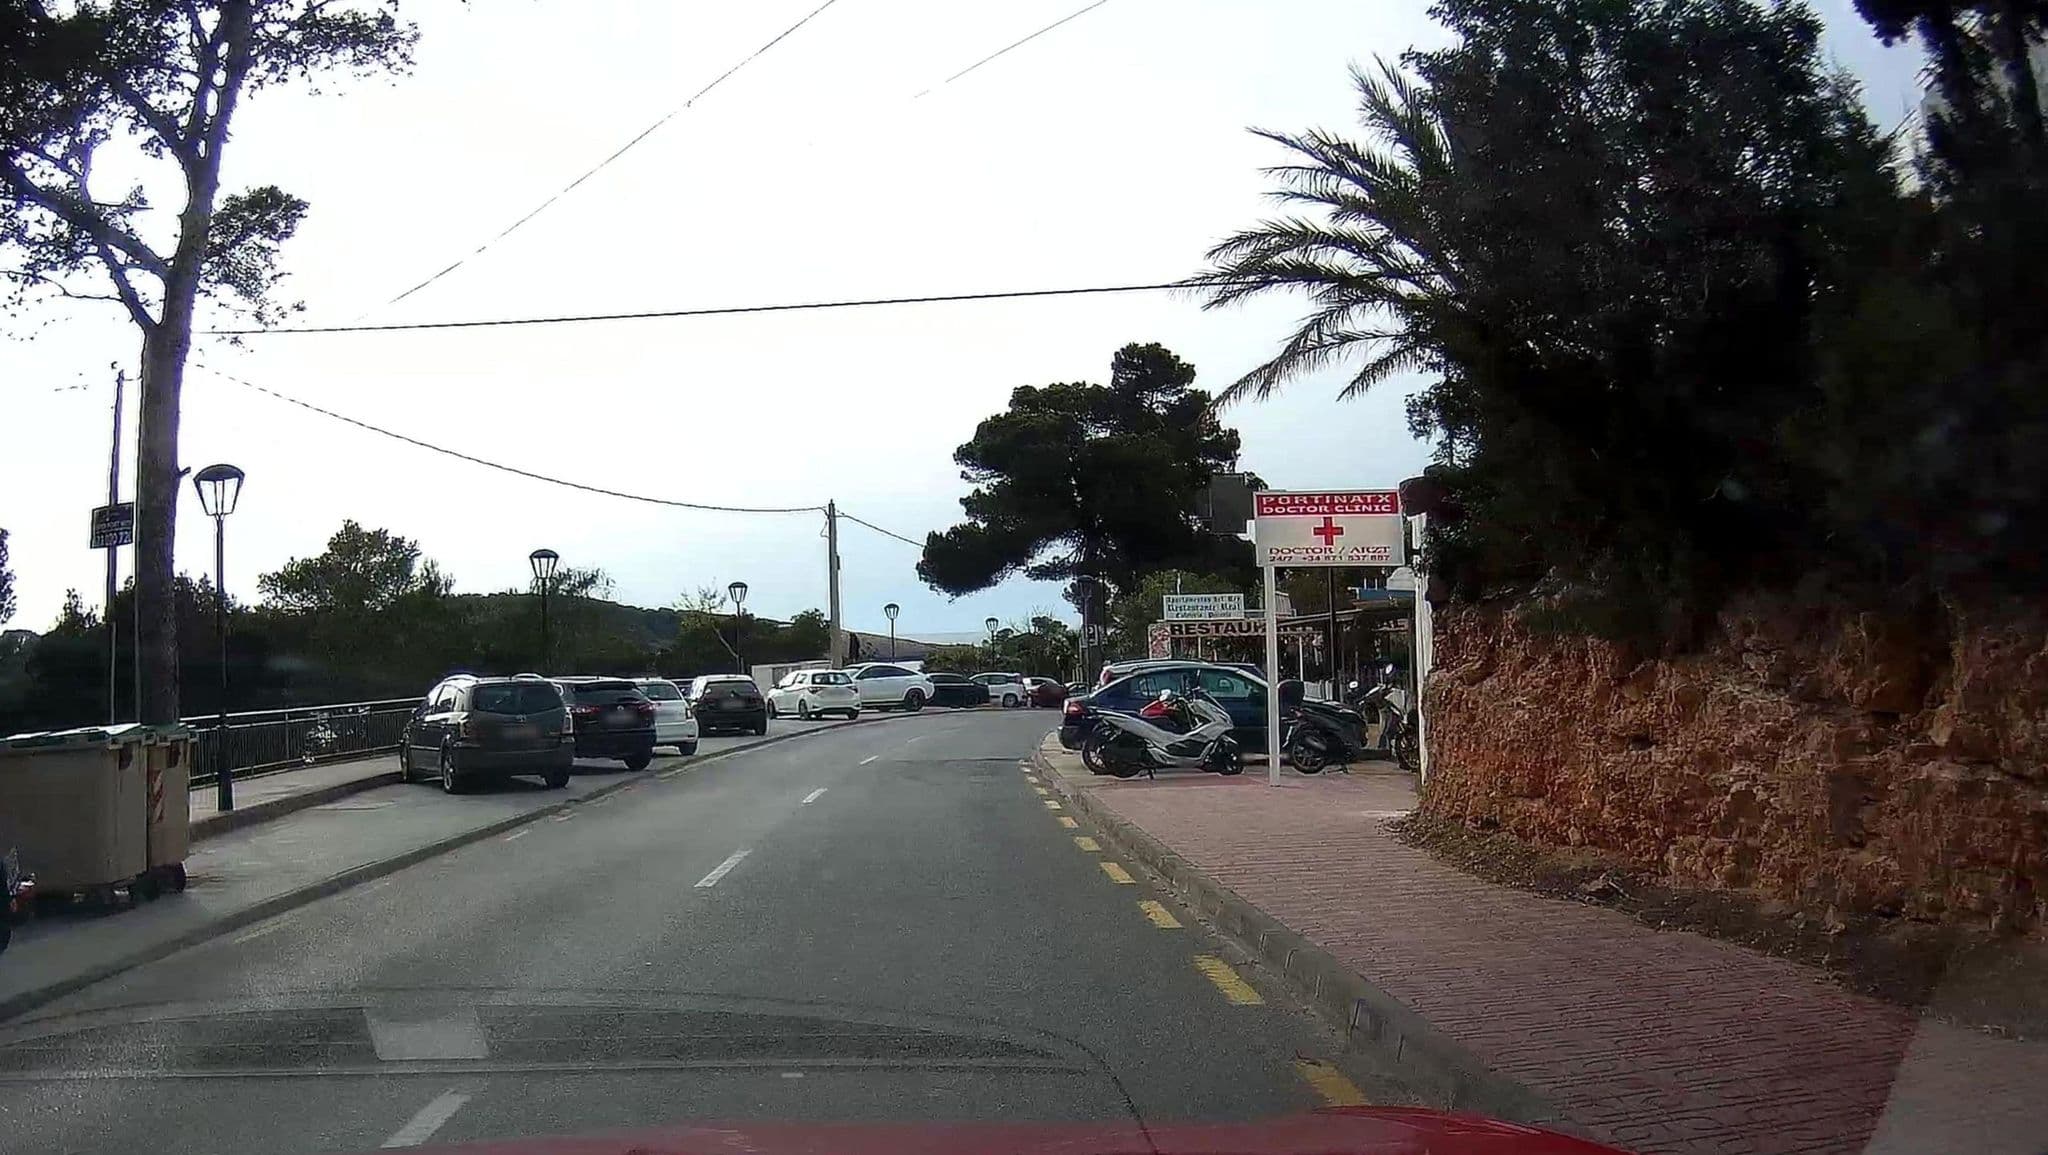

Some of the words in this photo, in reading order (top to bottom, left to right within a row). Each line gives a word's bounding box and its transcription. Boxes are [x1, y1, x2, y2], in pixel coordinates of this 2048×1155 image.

[1262, 493, 1391, 505] PORTINATX
[1263, 505, 1330, 514] DOCTOR
[1334, 504, 1392, 513] CLINIC
[1269, 547, 1334, 555] DOCTOR
[1350, 546, 1391, 554] ARZT
